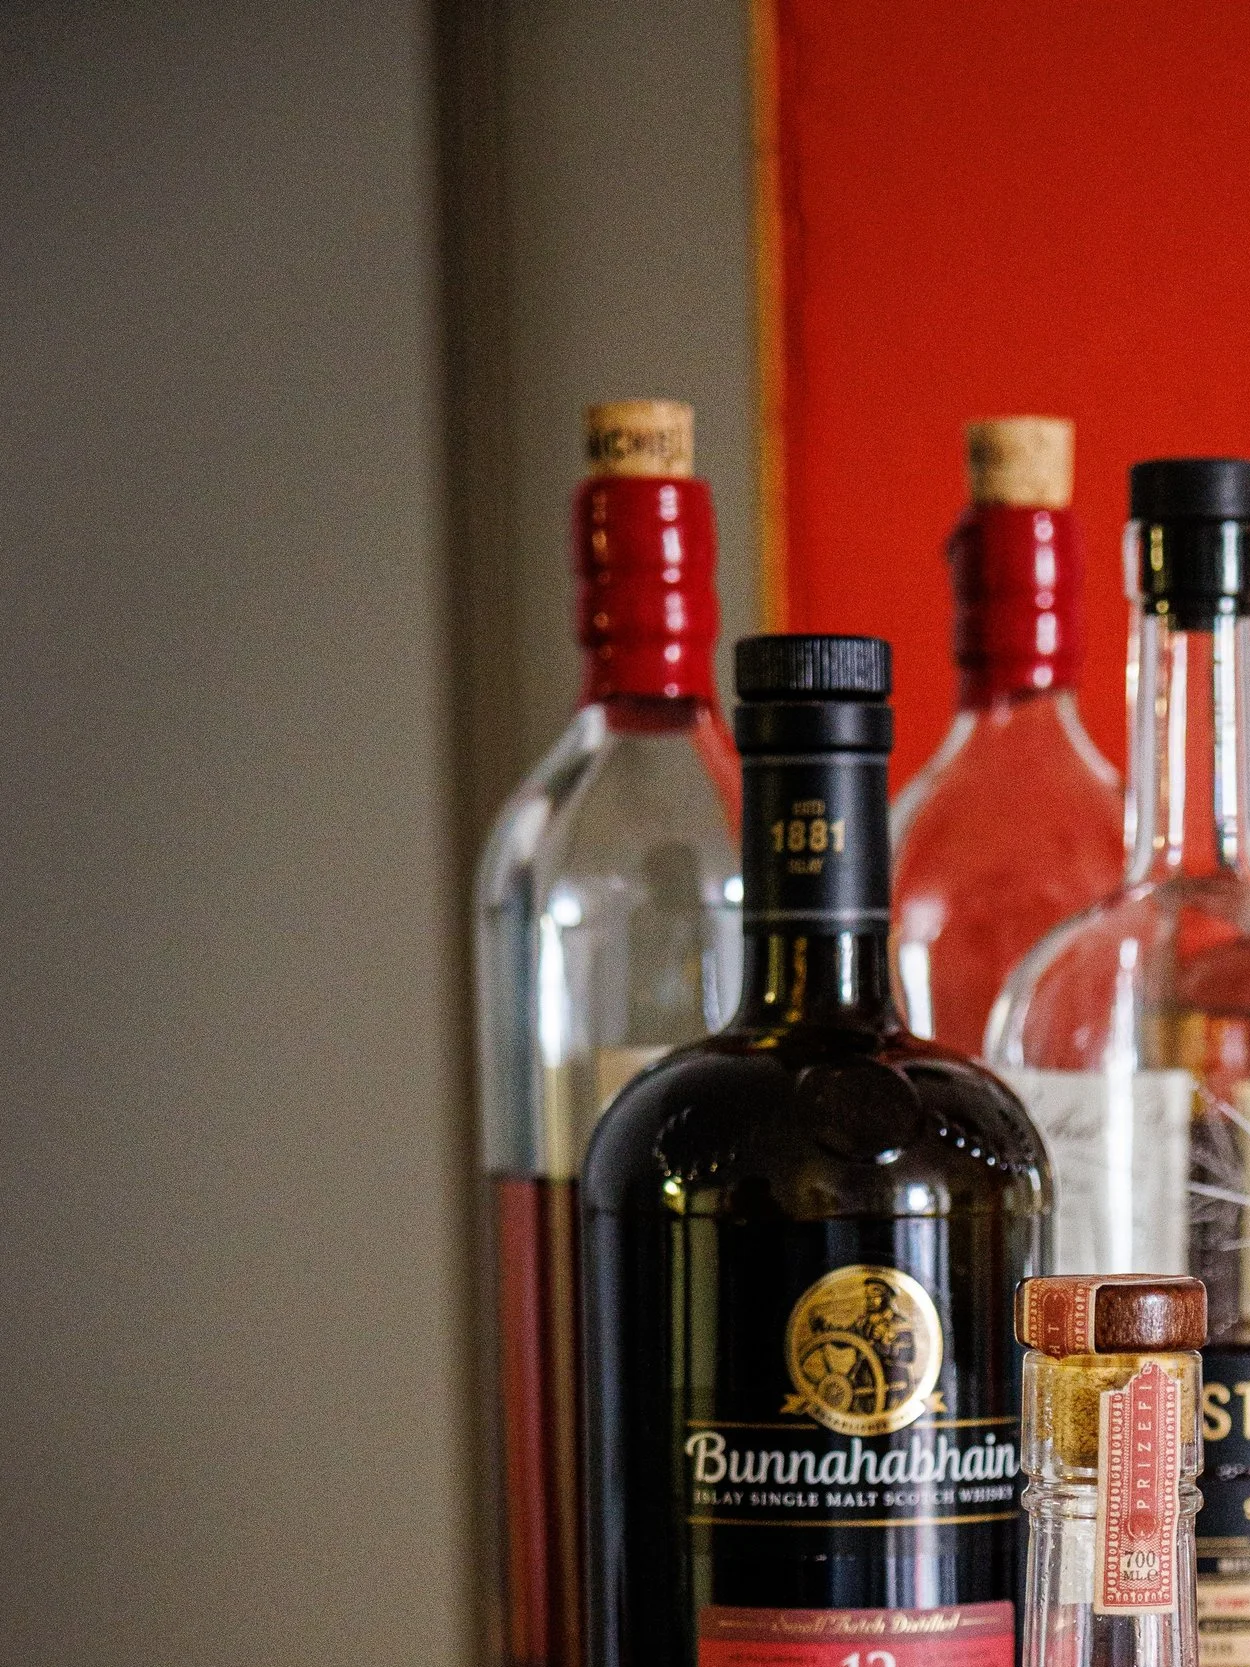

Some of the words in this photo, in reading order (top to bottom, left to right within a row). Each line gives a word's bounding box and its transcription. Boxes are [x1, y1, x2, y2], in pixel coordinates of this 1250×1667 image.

[769, 818, 846, 854] 1881
[685, 1431, 1019, 1485] Bunnahabhain
[694, 1489, 743, 1505] ISLAY
[751, 1491, 819, 1508] SINGLE
[825, 1491, 878, 1508] MALT
[1124, 1550, 1156, 1568] 700
[827, 1613, 886, 1634] Batch
[892, 1612, 961, 1634] Distilled
